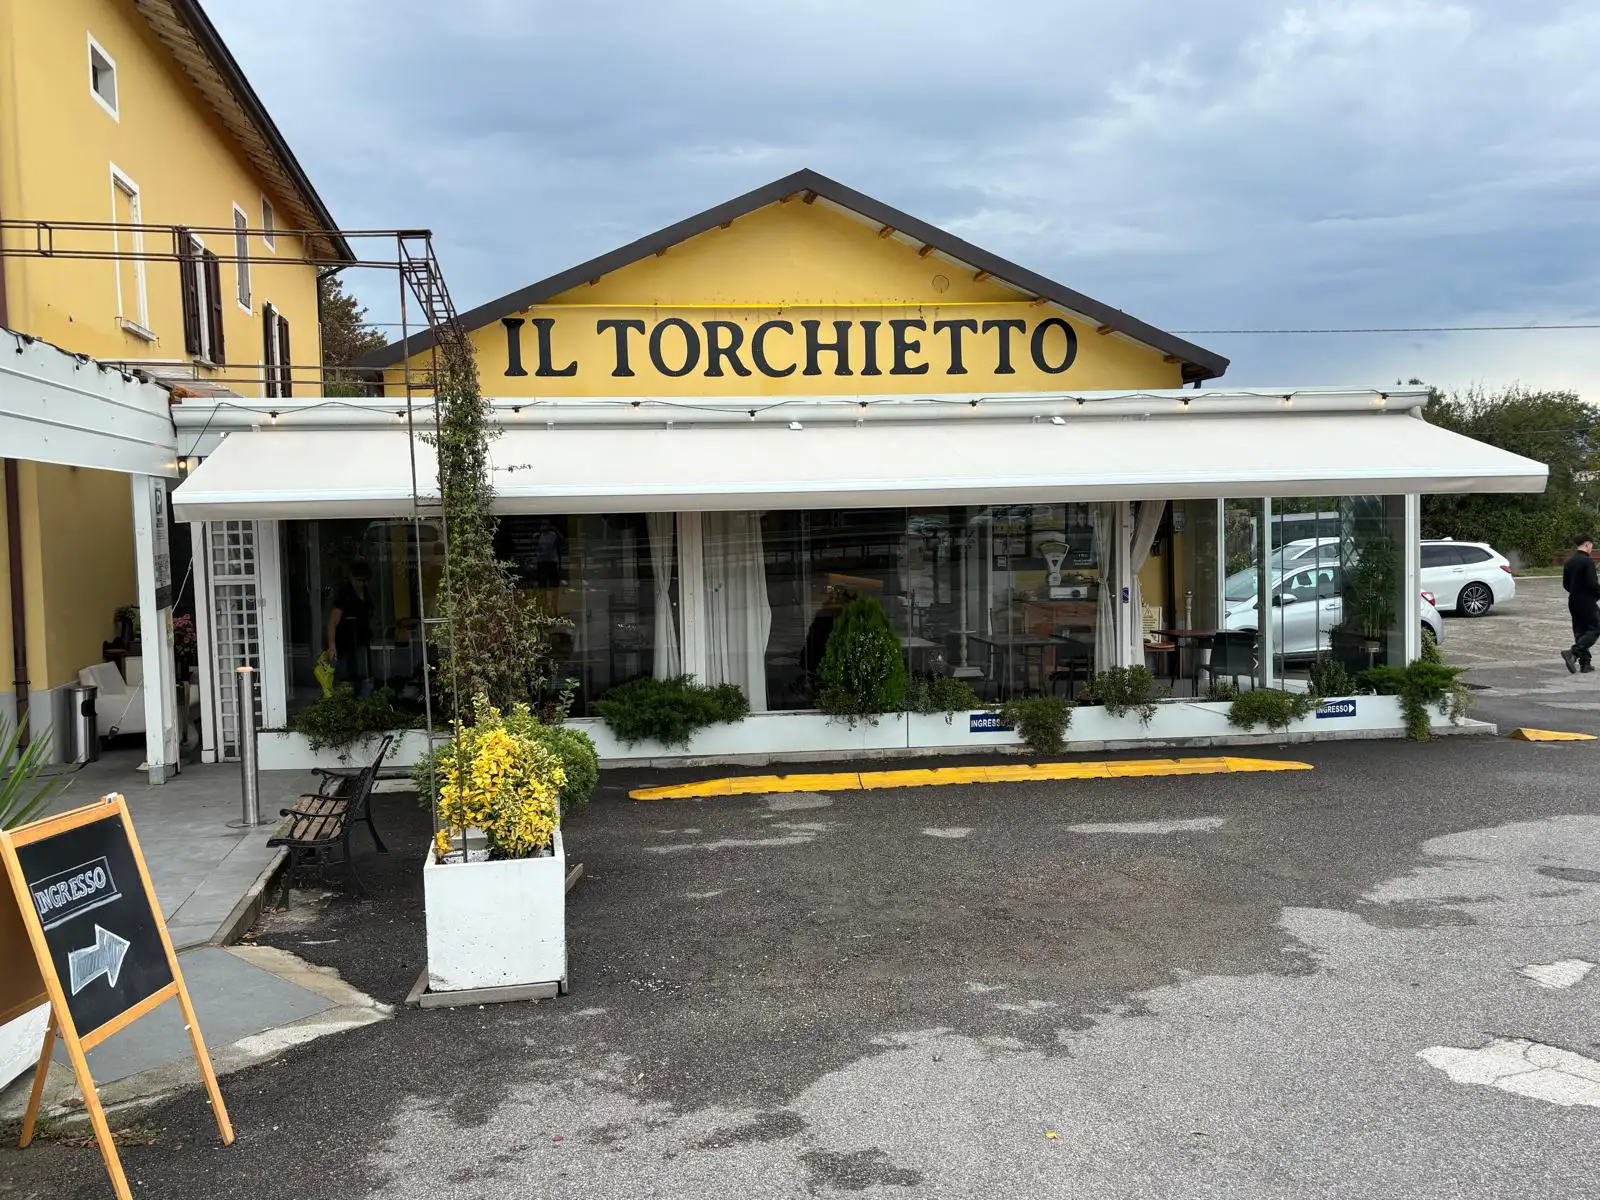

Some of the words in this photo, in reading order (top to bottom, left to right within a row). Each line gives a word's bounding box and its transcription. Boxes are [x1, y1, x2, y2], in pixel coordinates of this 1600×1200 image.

[501, 317, 578, 377] IL
[597, 317, 1078, 378] TORCHIETTO
[1316, 704, 1348, 714] INGRESSO
[34, 866, 107, 914] INGRESSO
